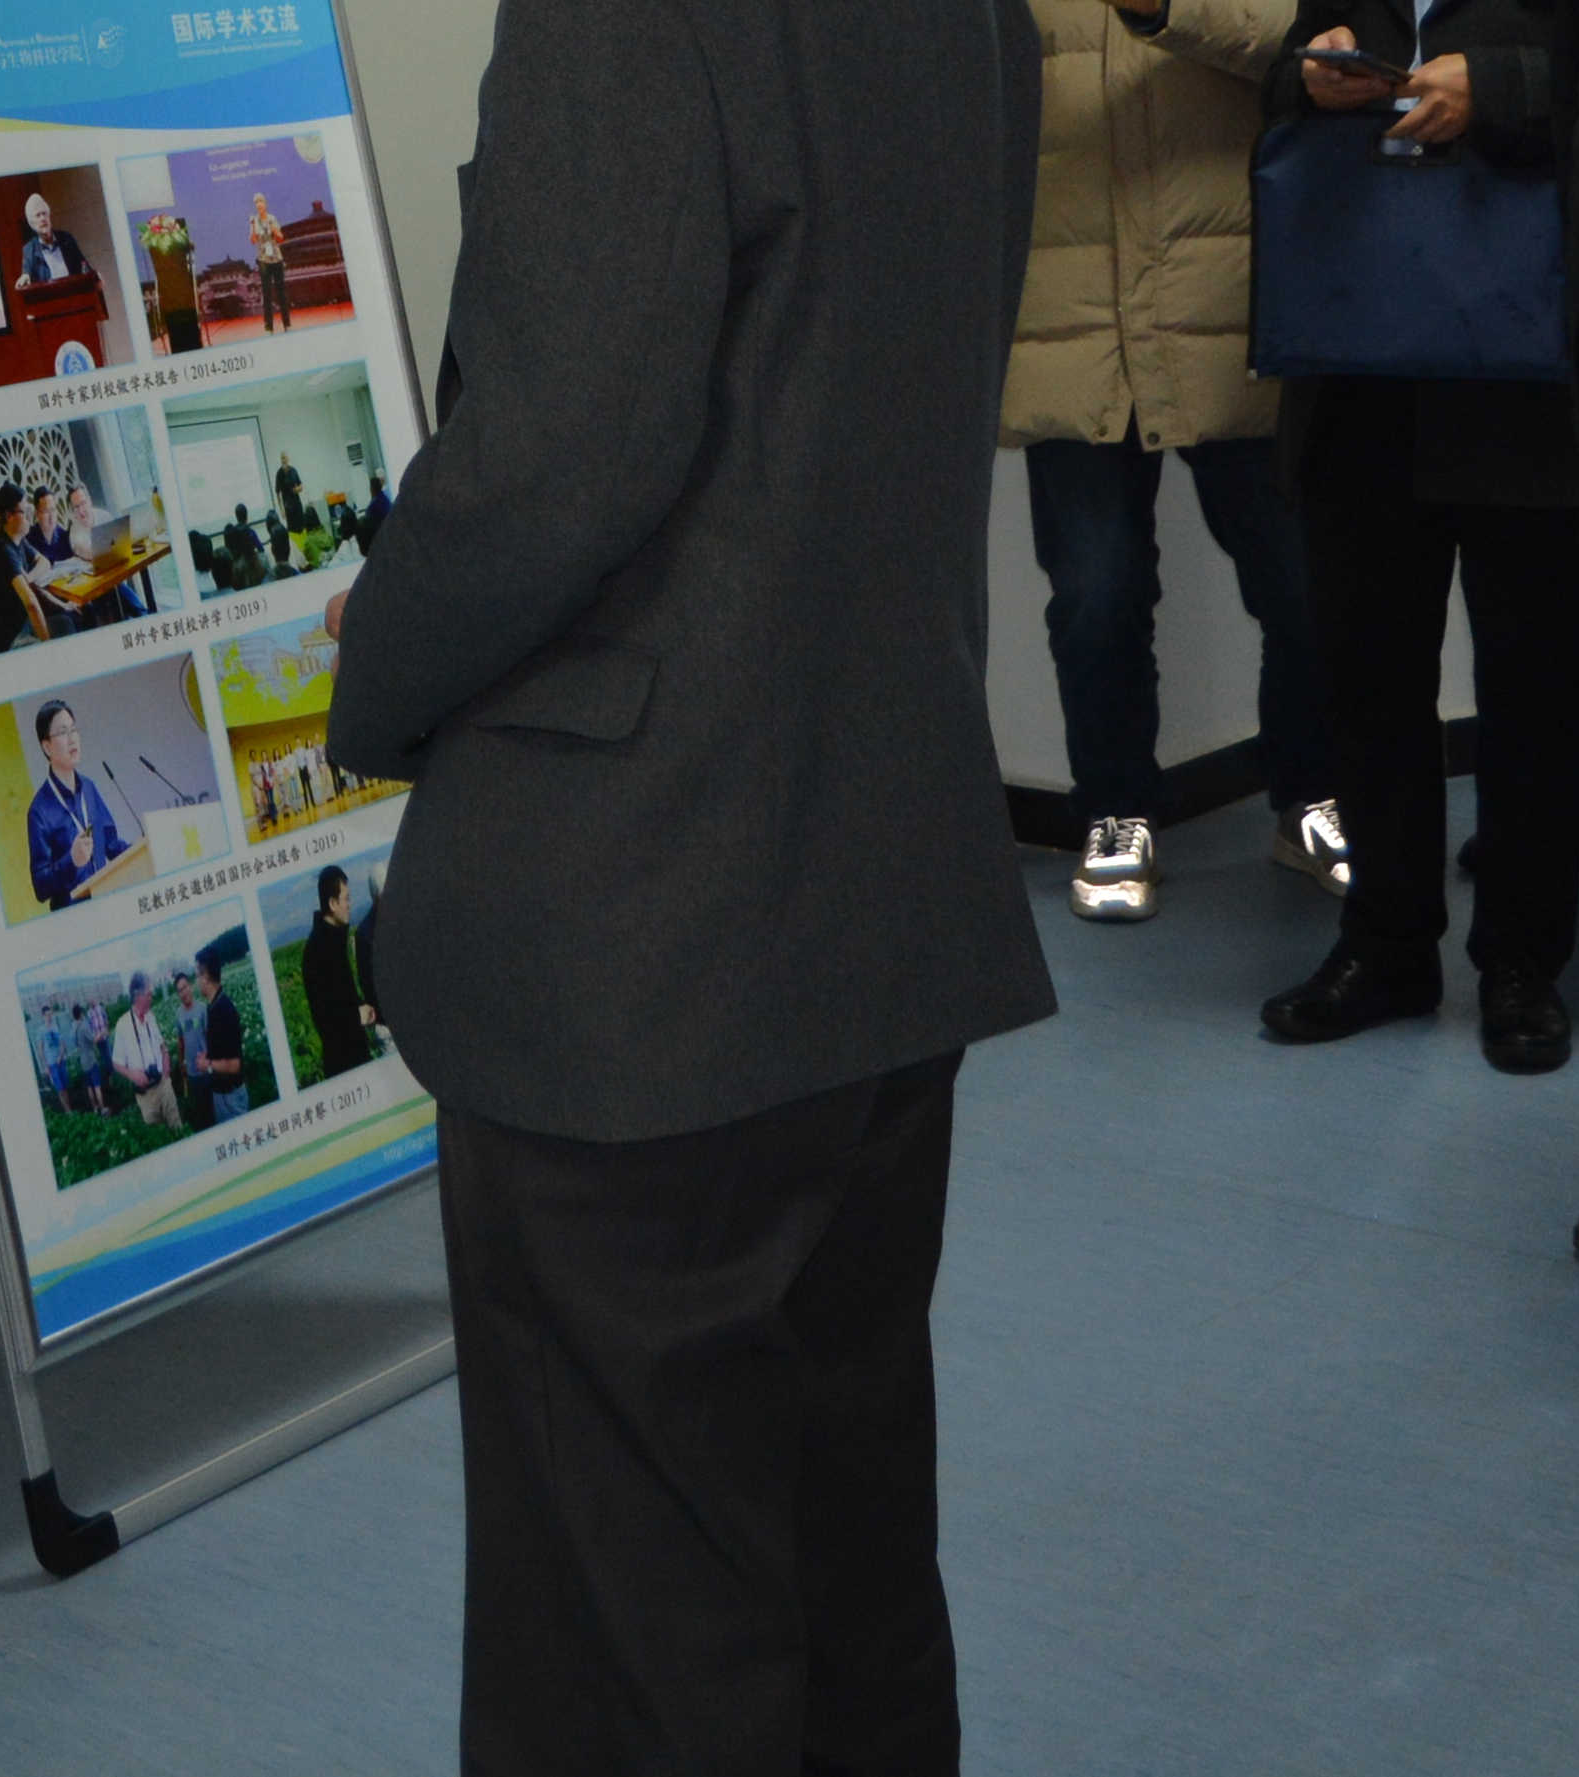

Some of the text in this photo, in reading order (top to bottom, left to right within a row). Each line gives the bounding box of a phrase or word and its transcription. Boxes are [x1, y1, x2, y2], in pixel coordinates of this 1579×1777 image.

[172, 3, 301, 44] 国际学术交流
